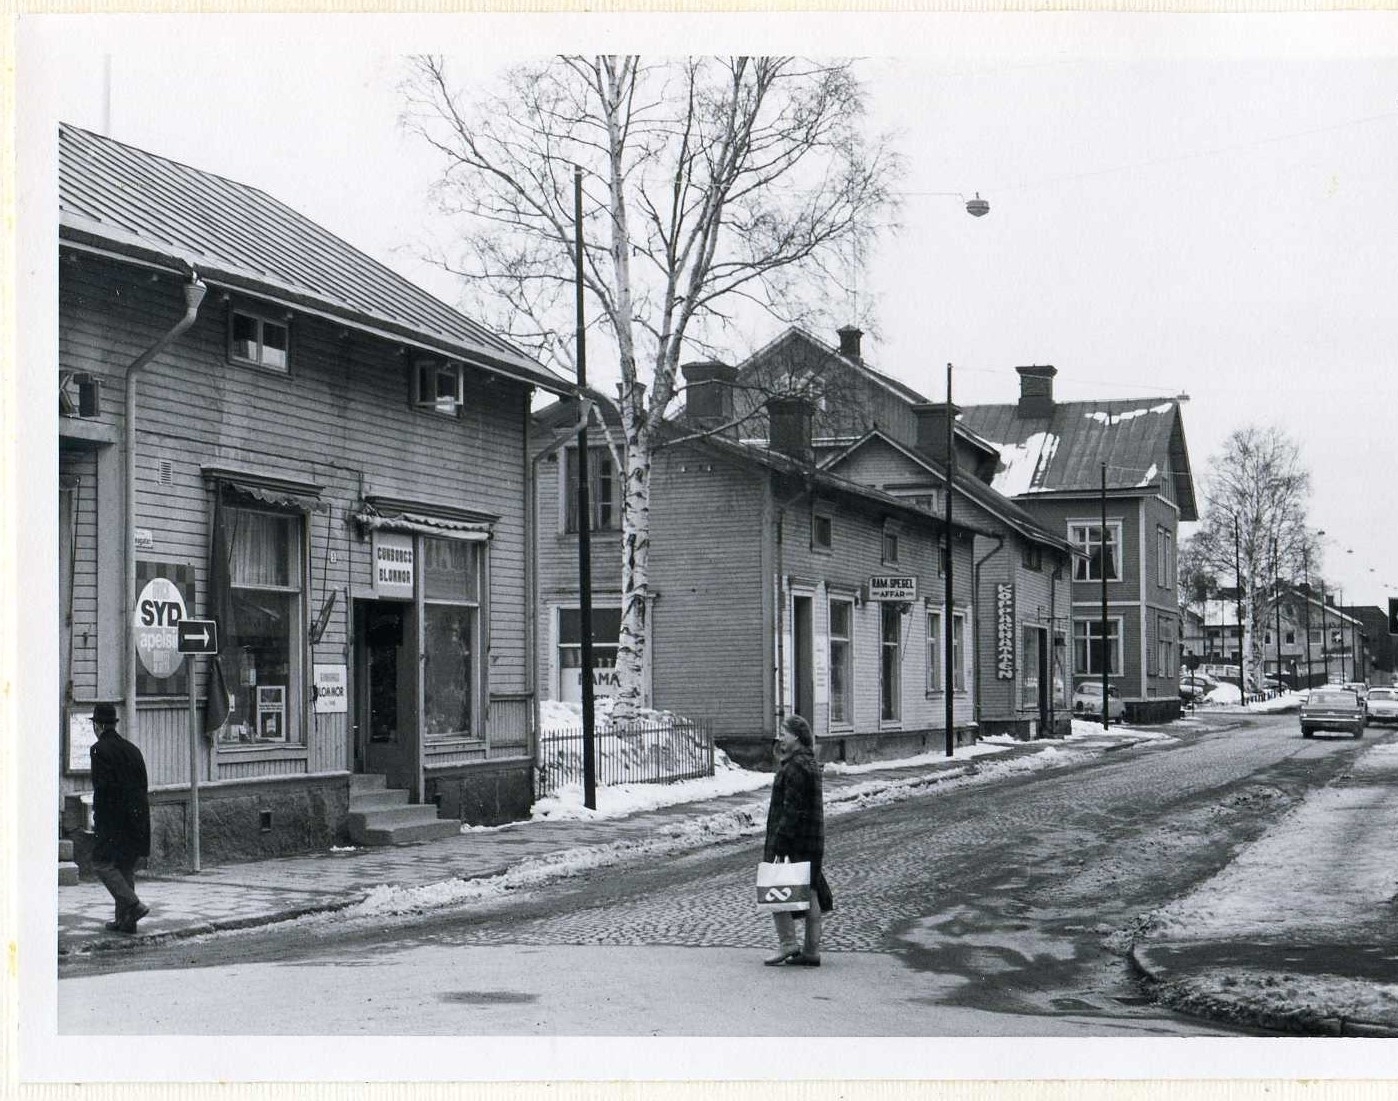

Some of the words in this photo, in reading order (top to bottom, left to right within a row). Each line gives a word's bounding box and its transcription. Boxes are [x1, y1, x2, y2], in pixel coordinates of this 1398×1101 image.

[379, 568, 411, 584] BLOMMOR
[140, 600, 182, 627] SYD
[140, 630, 178, 652] apelsi
[318, 686, 344, 697] LOMMOR
